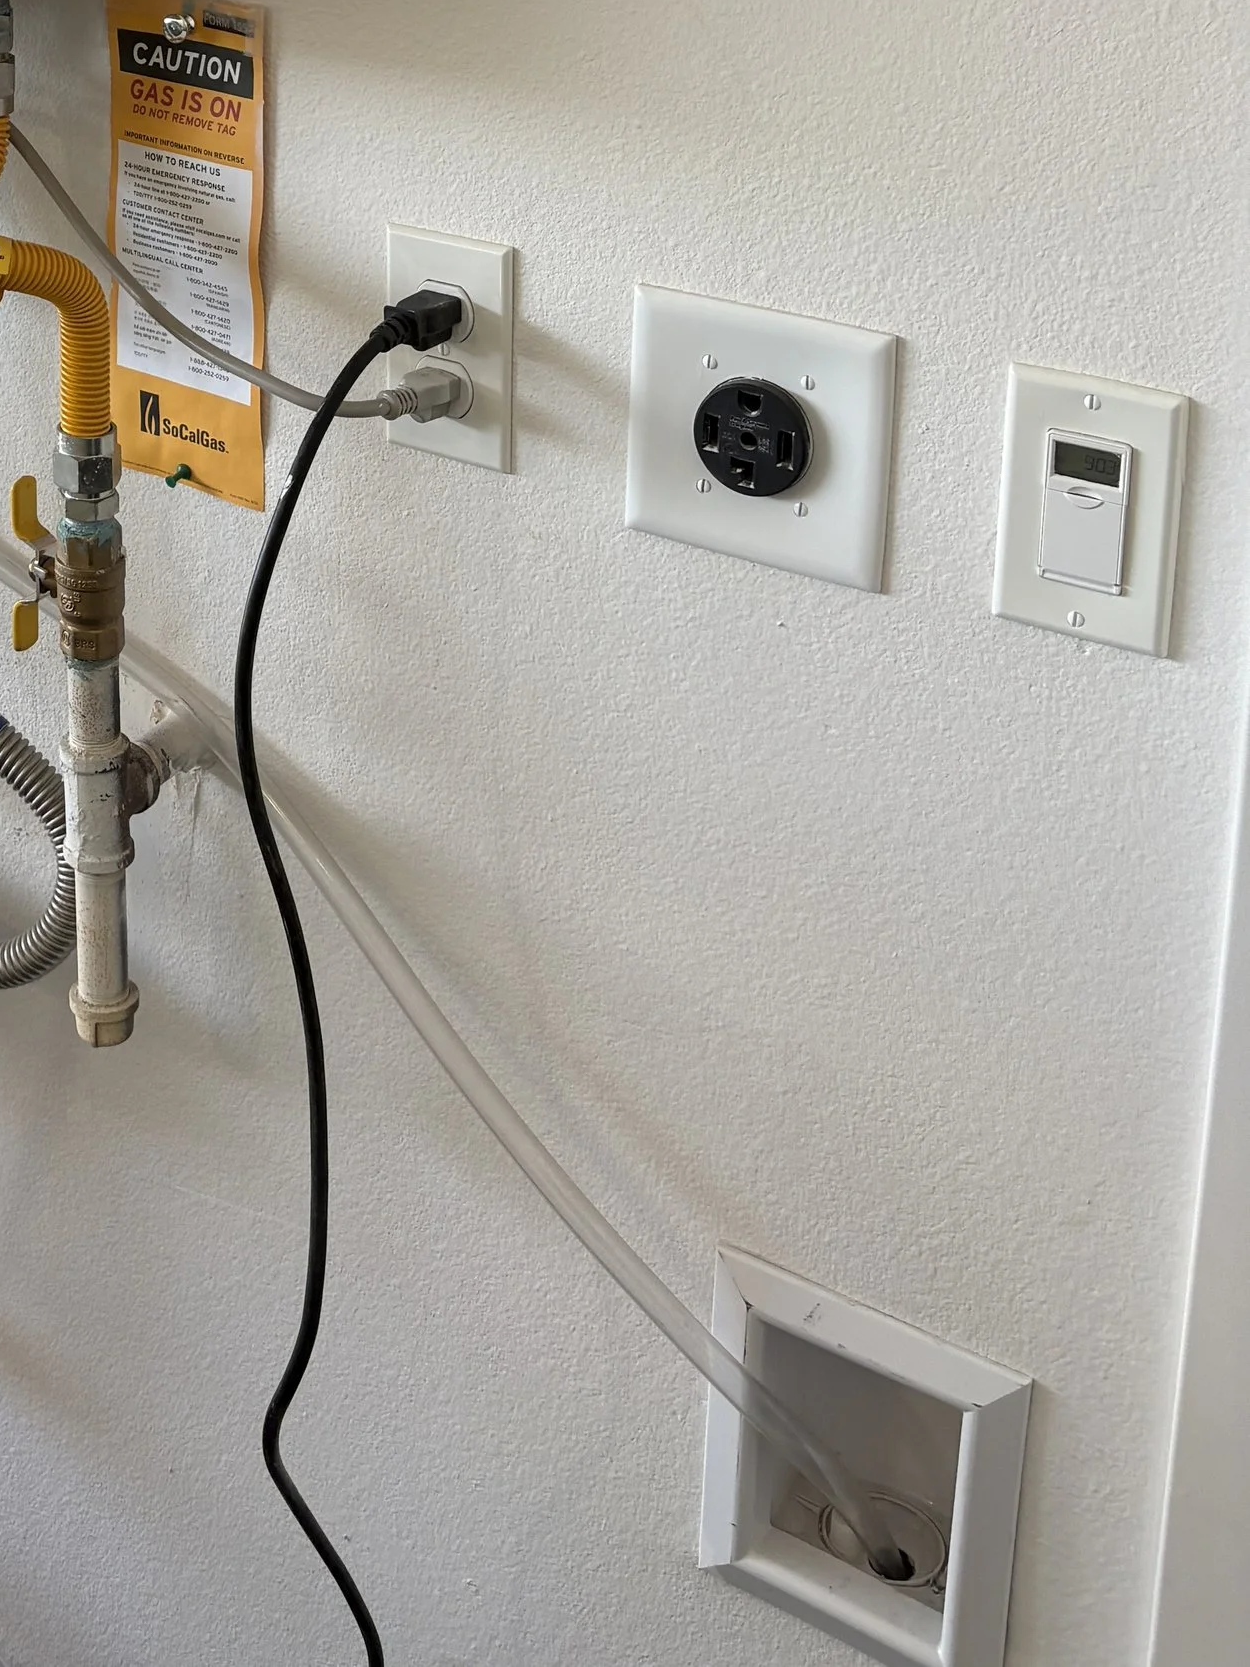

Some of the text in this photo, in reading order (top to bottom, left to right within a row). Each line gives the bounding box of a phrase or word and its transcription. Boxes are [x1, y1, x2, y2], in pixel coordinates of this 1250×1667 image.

[133, 42, 241, 84] CAUTION
[130, 78, 242, 122] GAS IS ON
[132, 104, 236, 137] DO NOT REMOVE TAG
[124, 130, 245, 164] IMPORTANT INFORMATION ON REVERSE
[125, 161, 225, 192] 24-HOUR EMERGENCY RESPONSE
[145, 152, 220, 176] HOW TO REACH US
[123, 199, 204, 225] CUSTOMER CONTACT CENTER
[122, 246, 204, 274] MULTILINGUAL CALL CENTER
